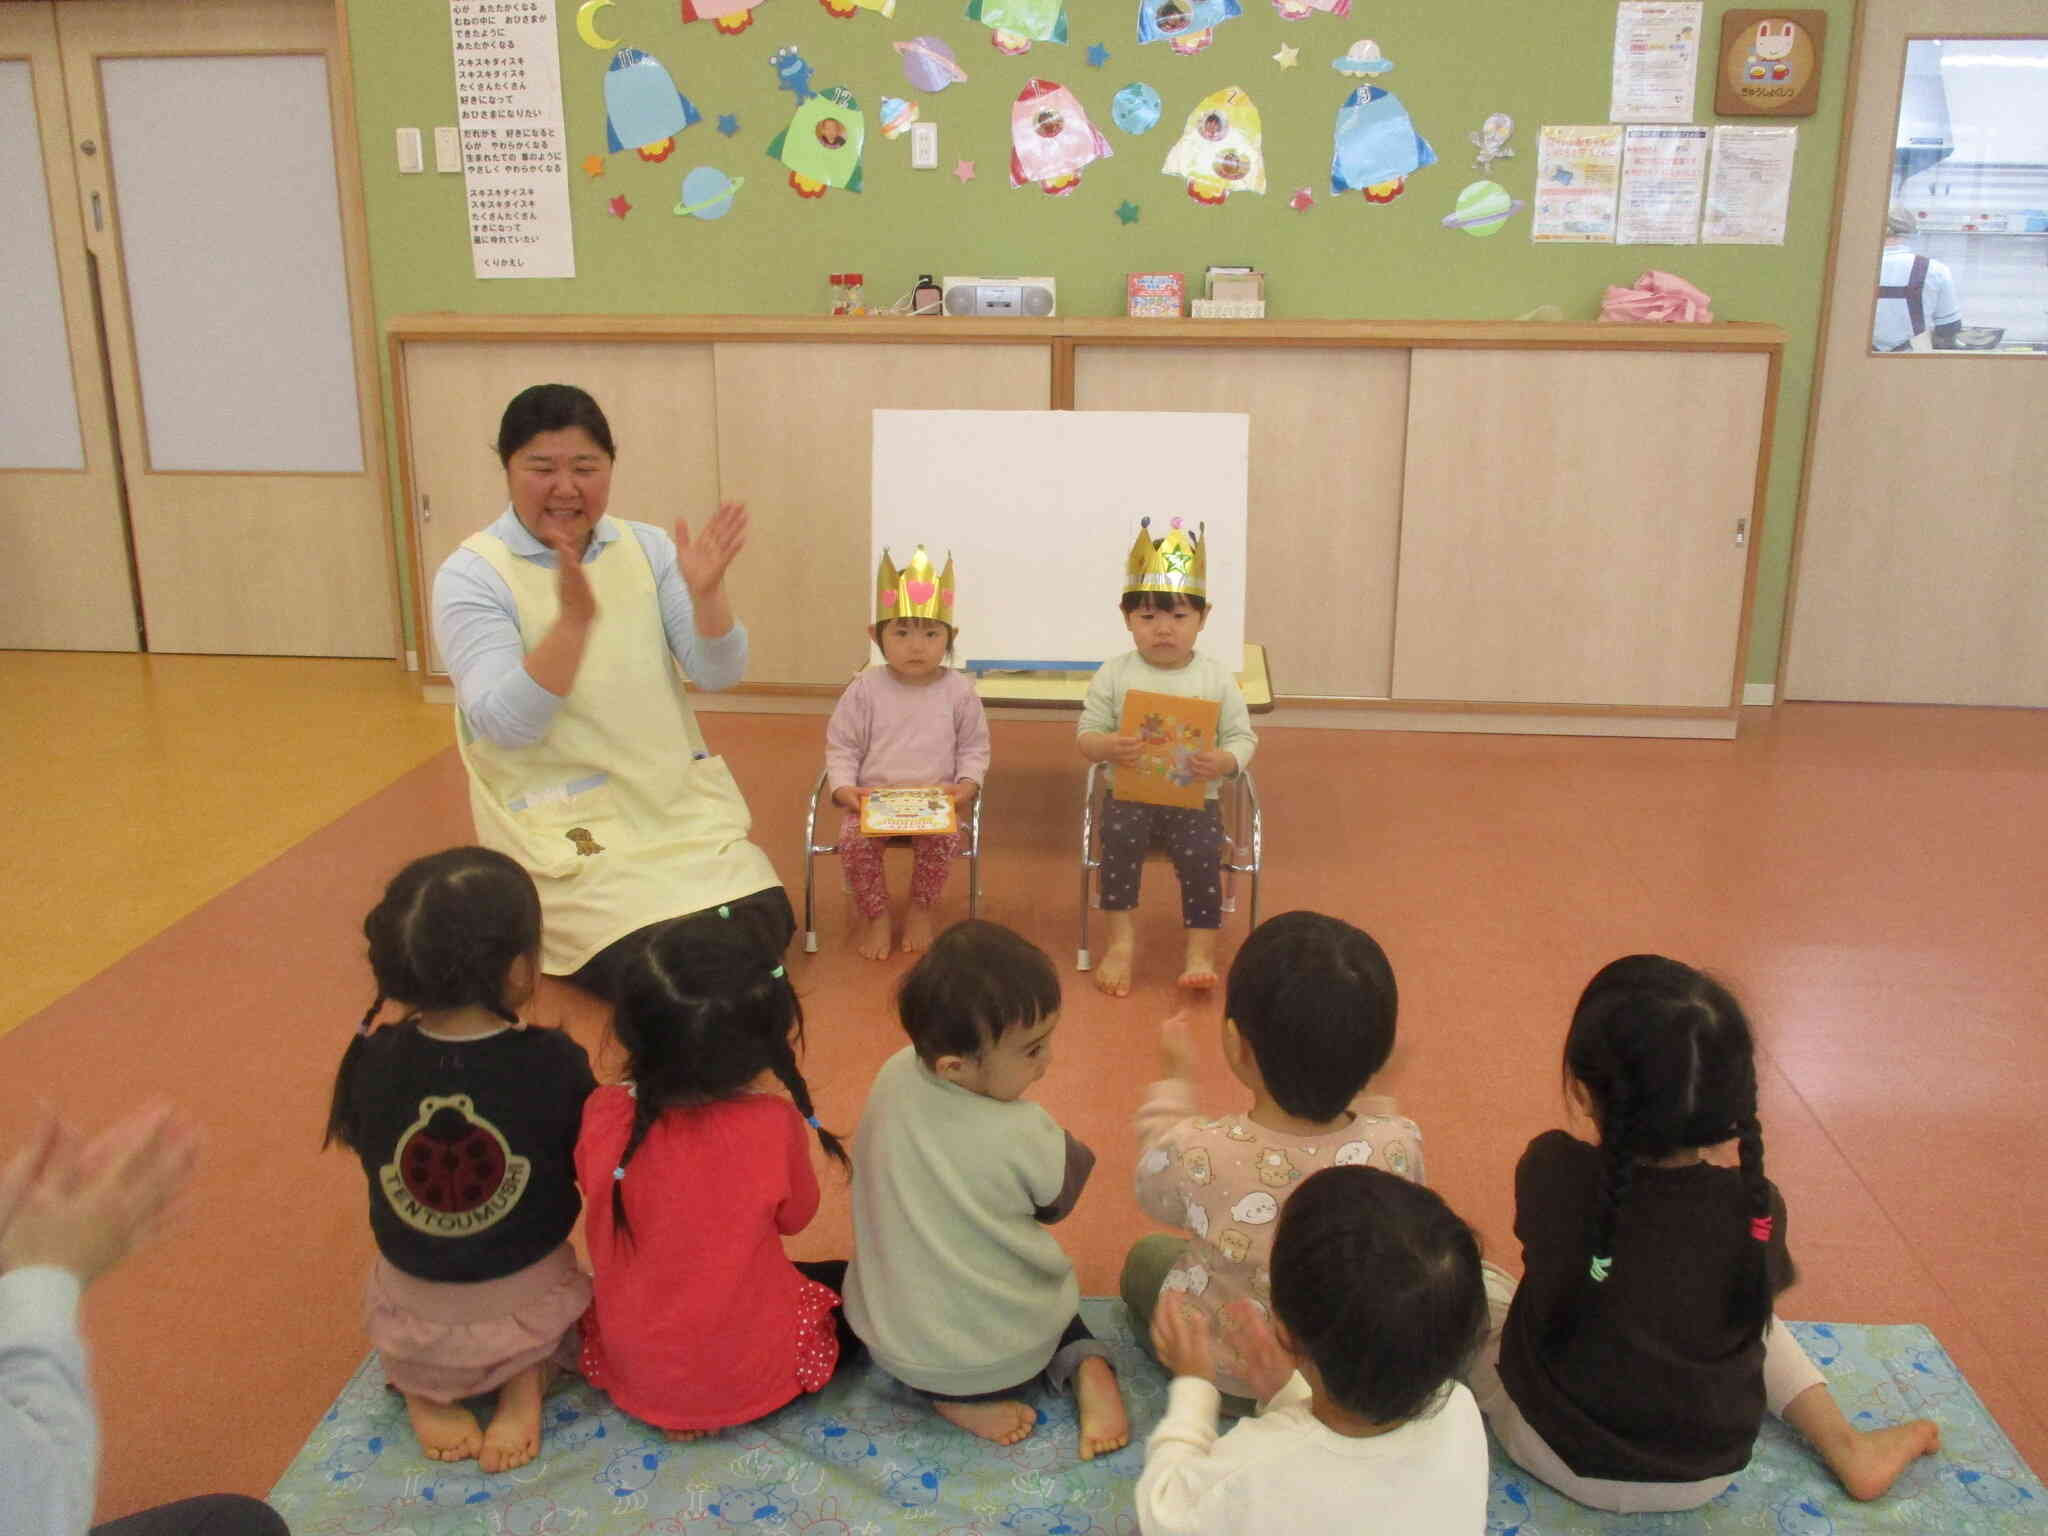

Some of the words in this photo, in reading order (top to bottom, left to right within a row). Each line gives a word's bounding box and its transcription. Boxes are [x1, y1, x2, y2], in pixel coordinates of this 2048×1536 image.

[453, 4, 470, 14] 心が
[479, 3, 537, 13] あたたかくなる
[454, 16, 496, 25] むねの中に
[505, 14, 546, 24] おひさまが
[456, 28, 505, 38] できたように
[456, 40, 515, 50] あたたかくなる
[458, 57, 524, 66] スキスキダイスキ
[459, 70, 525, 79] スキスキダイスキ
[460, 82, 527, 91] たくさんたくさん
[460, 95, 513, 104] 好きになって
[491, 140, 548, 150] やわらかくなる
[505, 164, 561, 174] やわらかくなる
[472, 212, 537, 221] たくさんたくさん
